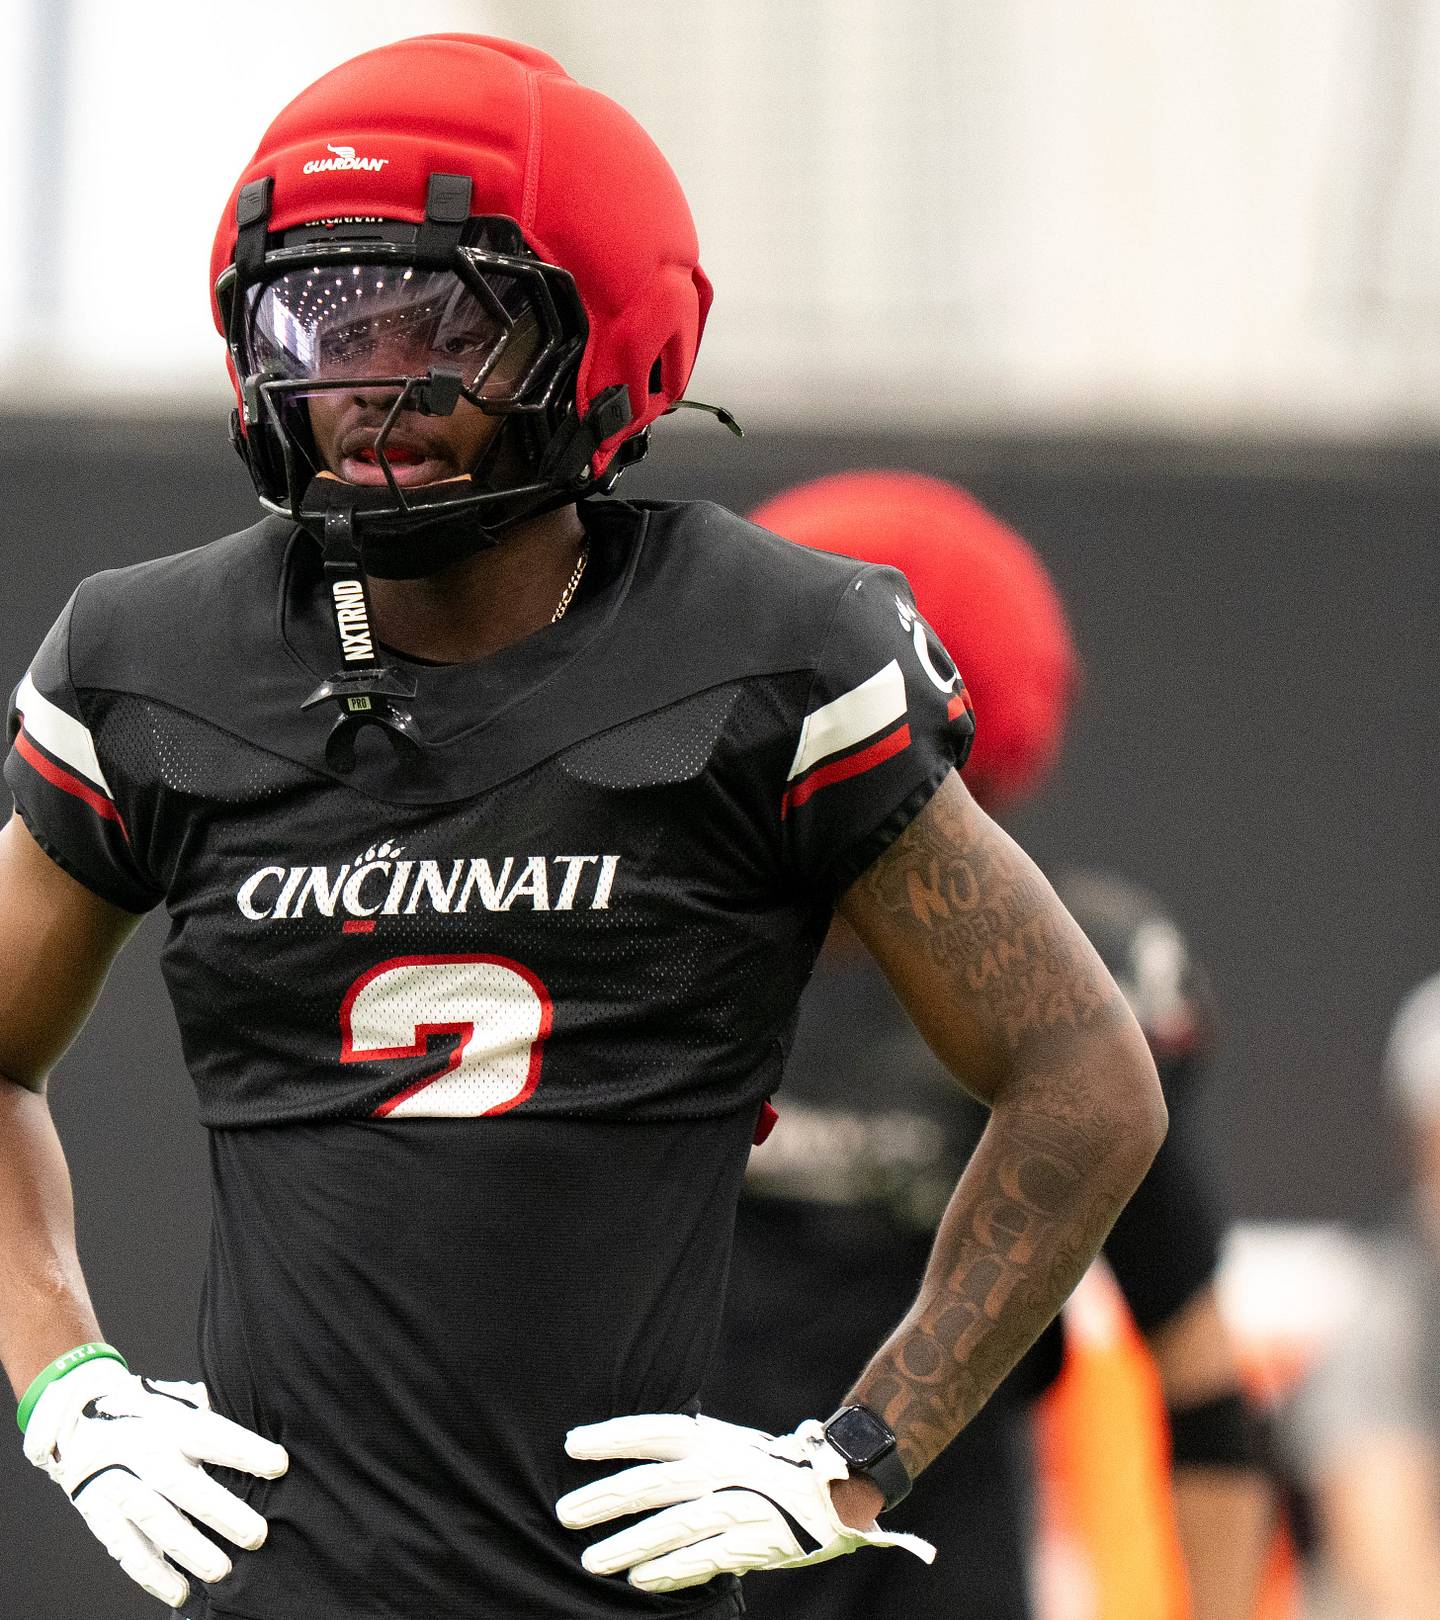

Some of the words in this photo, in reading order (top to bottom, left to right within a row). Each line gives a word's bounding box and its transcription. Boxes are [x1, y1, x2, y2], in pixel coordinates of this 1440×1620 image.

[303, 157, 384, 174] GUARDIAN
[332, 580, 375, 661] NXTRND
[351, 697, 367, 710] PRO
[236, 854, 621, 921] CINCINNATI
[339, 953, 554, 1118] 2
